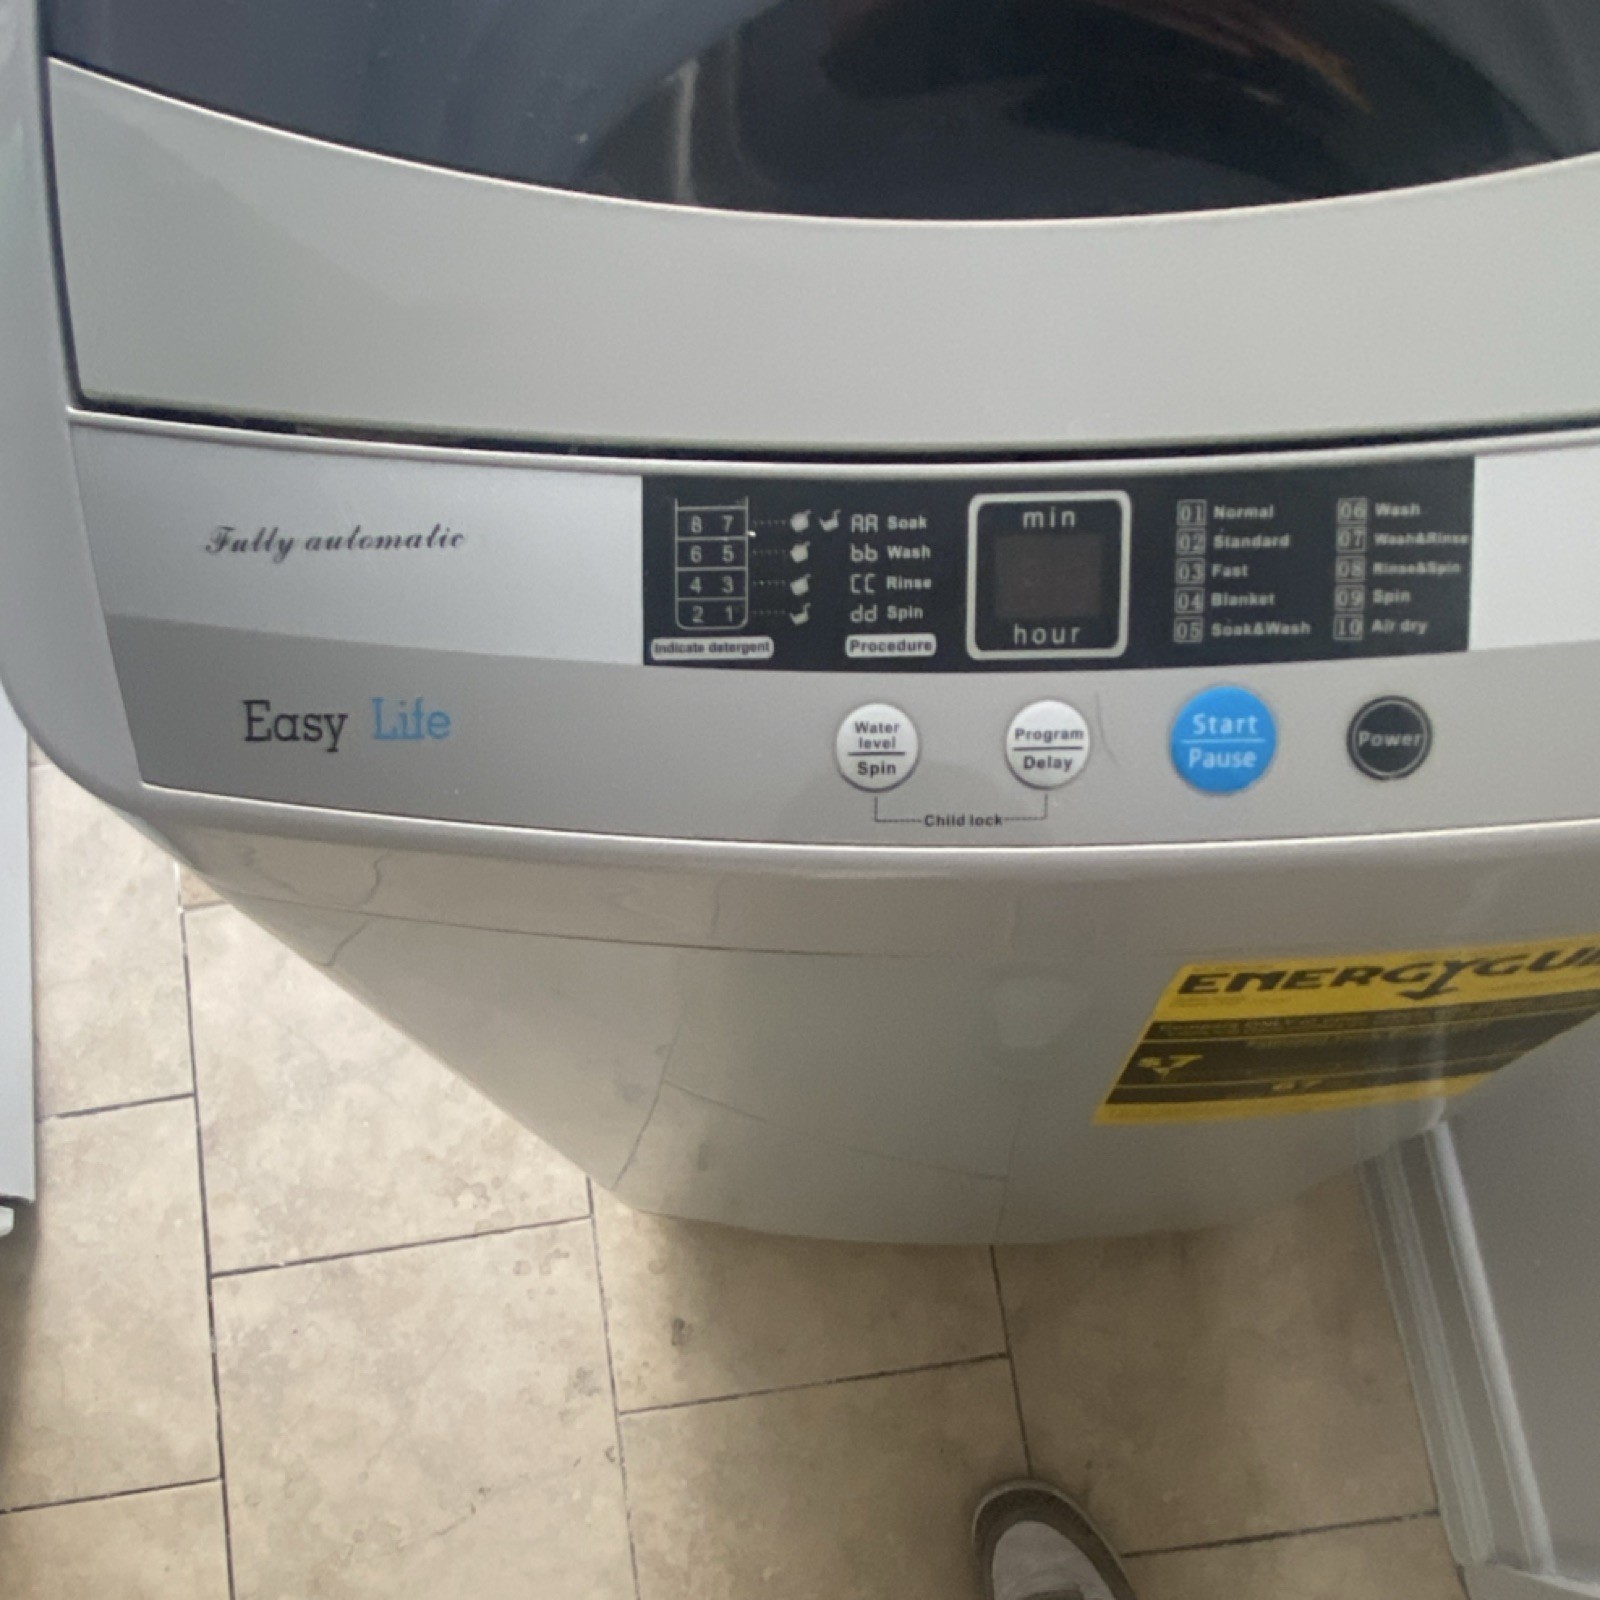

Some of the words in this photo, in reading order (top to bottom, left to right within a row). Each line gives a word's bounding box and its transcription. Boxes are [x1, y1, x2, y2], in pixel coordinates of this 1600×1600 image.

[1023, 506, 1076, 529] min
[1180, 503, 1204, 523] 01
[1213, 504, 1274, 519] Normal
[1375, 503, 1421, 516] Wash
[690, 516, 702, 533] 8
[722, 516, 734, 532] 7
[887, 514, 928, 530] Soak
[205, 524, 295, 564] Fully
[304, 522, 466, 554] automatic
[1179, 532, 1204, 552] 02
[1213, 533, 1290, 549] Standard
[1374, 533, 1469, 545] Wash&Rinse
[690, 544, 702, 563] 6
[722, 545, 734, 562] 5
[850, 544, 878, 563] bb
[887, 545, 930, 560] Wash
[1211, 563, 1249, 578] Fast
[1373, 561, 1461, 577] Rinse&Spin
[690, 576, 702, 593] 4
[722, 576, 734, 593] 3
[886, 576, 932, 590] Rinse
[1177, 591, 1203, 610] 04
[1211, 591, 1275, 607] Blanket
[1372, 589, 1410, 605] Spin
[692, 606, 704, 623] 2
[724, 605, 733, 622] 1
[850, 604, 878, 624] dd
[886, 606, 924, 622] Spin
[1014, 624, 1081, 645] hour
[1211, 621, 1311, 637] Soak&Wash
[1371, 619, 1394, 633] Air
[1400, 618, 1429, 635] dry
[708, 641, 770, 656] detergent
[849, 639, 933, 654] Procedure
[242, 699, 348, 753] Easy
[371, 696, 452, 740] Life
[853, 721, 900, 734] Water
[1192, 713, 1258, 735] Start
[858, 736, 897, 750] level
[1014, 727, 1085, 742] Program
[1358, 729, 1424, 749] Power
[1023, 755, 1074, 773] Delay
[1188, 749, 1257, 769] Pause
[856, 761, 897, 776] Spin
[924, 813, 966, 828] Child
[969, 813, 1003, 828] lock
